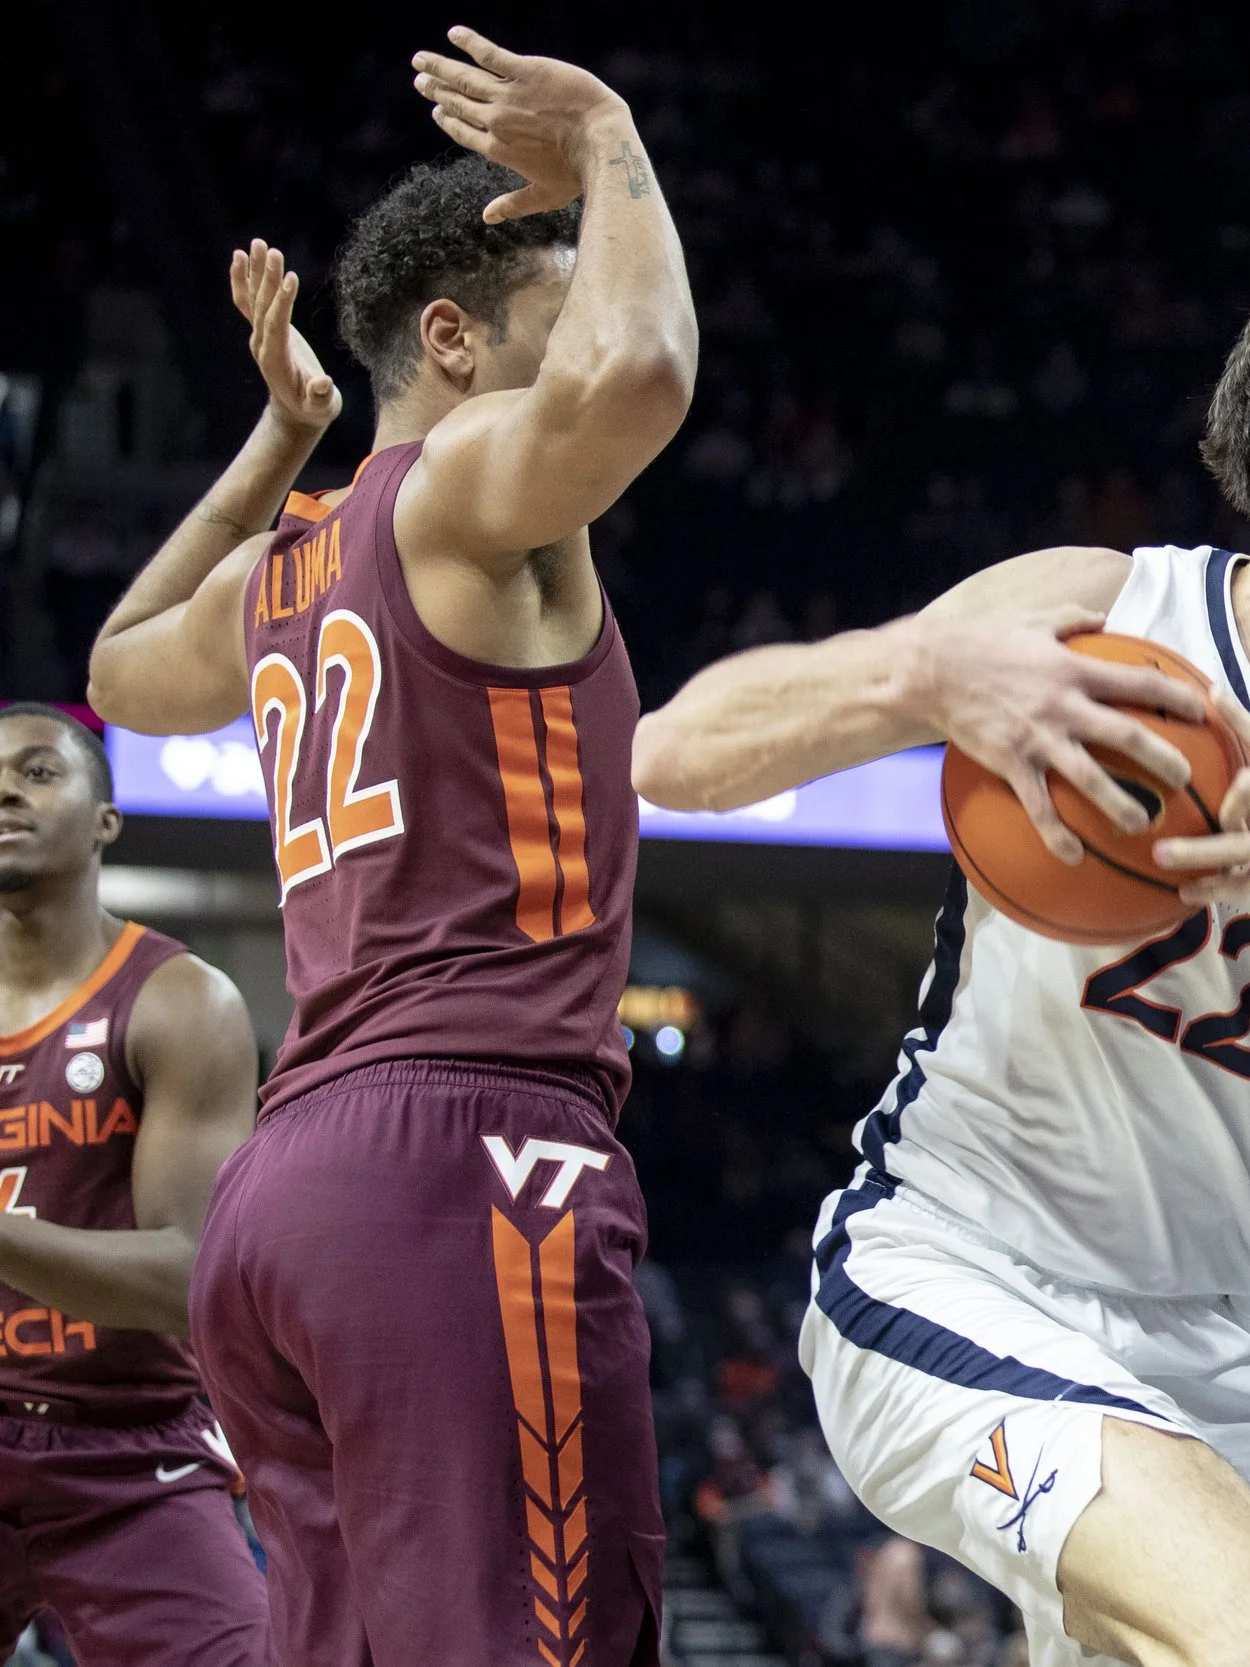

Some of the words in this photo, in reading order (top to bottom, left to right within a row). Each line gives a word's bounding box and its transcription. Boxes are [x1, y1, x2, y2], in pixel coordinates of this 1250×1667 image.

[255, 519, 342, 629] ALUMA
[251, 609, 404, 907] 22
[480, 1134, 612, 1209] VT
